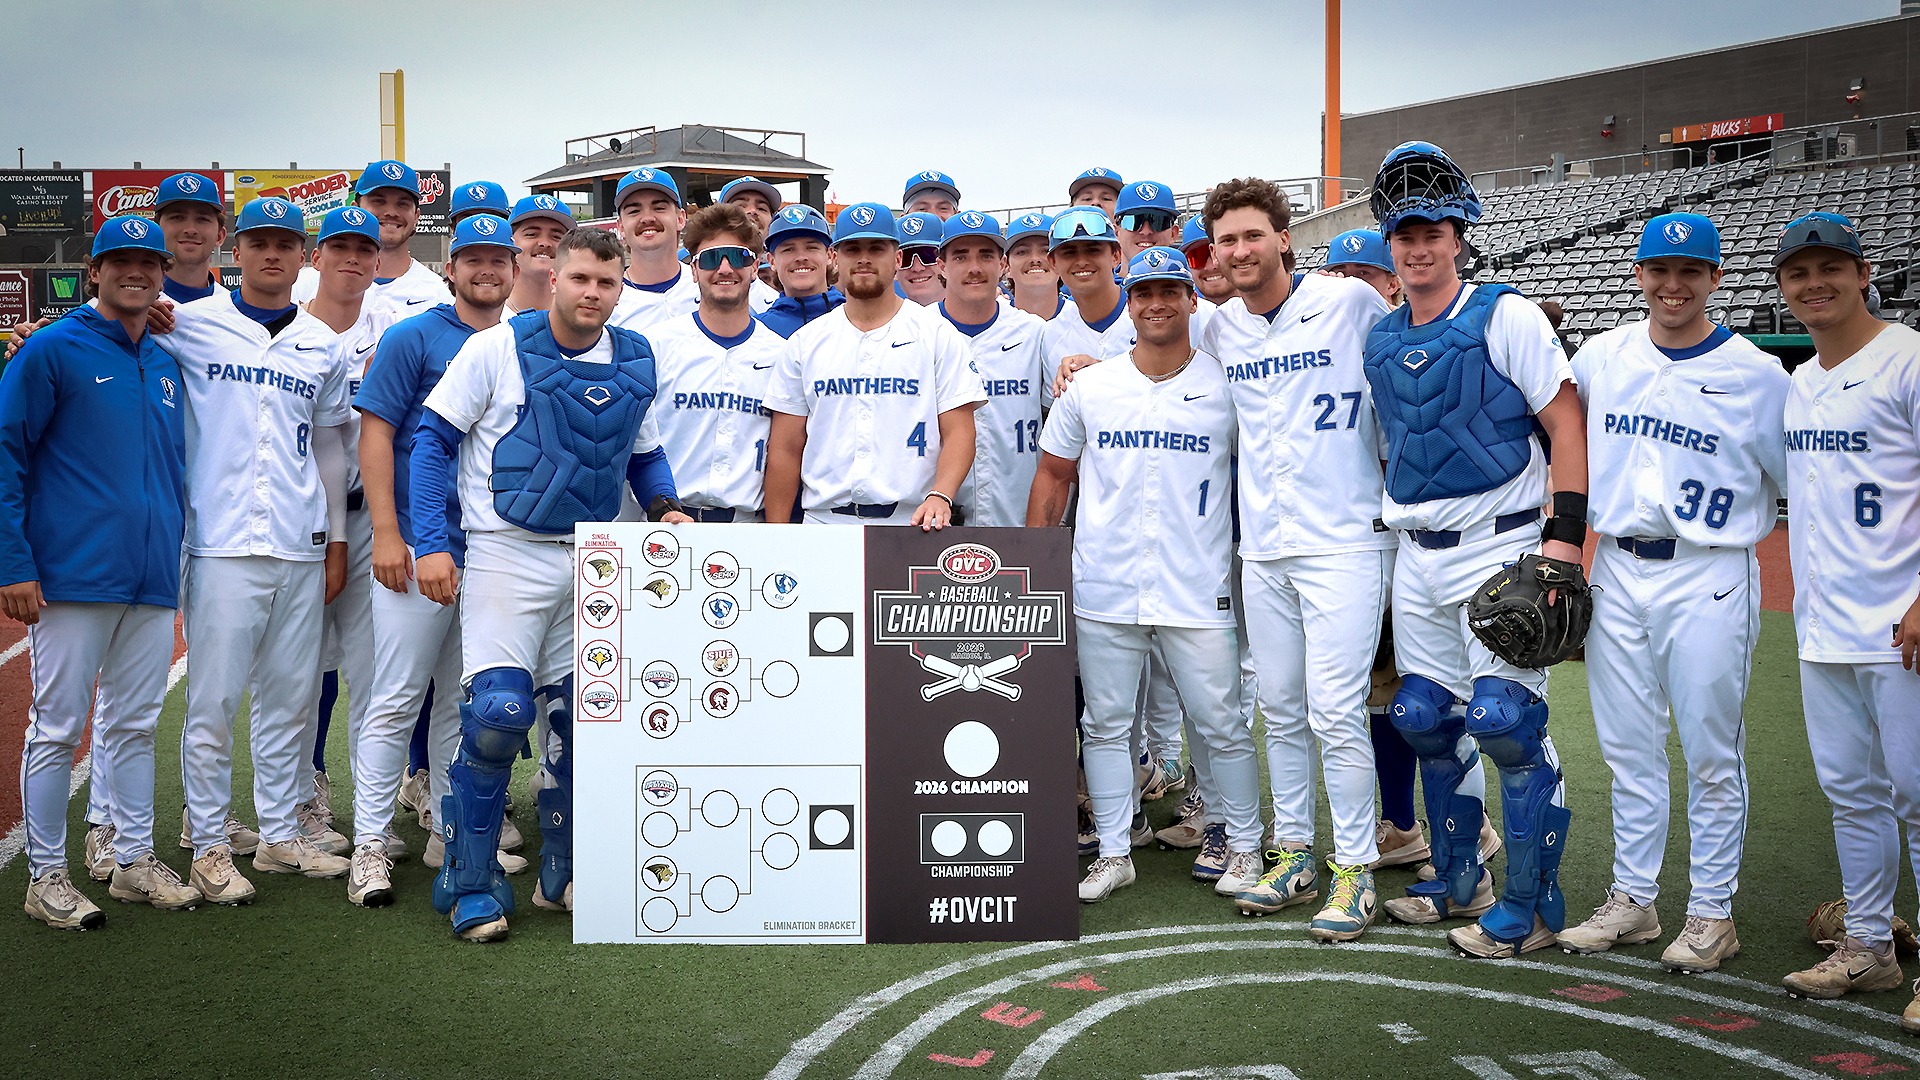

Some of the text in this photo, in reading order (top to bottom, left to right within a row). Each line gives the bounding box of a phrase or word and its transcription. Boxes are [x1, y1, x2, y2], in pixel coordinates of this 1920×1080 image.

[1710, 119, 1741, 138] BUCKS
[288, 173, 349, 203] PONDER
[304, 192, 334, 207] SERVICE
[310, 199, 343, 215] COOLING
[0, 281, 22, 292] ance
[0, 313, 21, 326] 37
[1226, 348, 1332, 384] PANTHERS
[207, 363, 317, 401] PANTHERS
[813, 377, 920, 397] PANTHERS
[983, 378, 1029, 397] HERS
[674, 391, 772, 417] PANTHER
[1313, 390, 1362, 433] 27
[296, 422, 310, 457] 8
[906, 421, 927, 457] 4
[1014, 419, 1038, 454] 13
[1098, 429, 1210, 454] PANTHERS
[1604, 413, 1720, 456] PANTHERS
[1198, 479, 1210, 517] 1
[1674, 478, 1735, 530] 38
[1852, 482, 1883, 529] 6
[591, 533, 610, 541] SINGLE
[652, 550, 676, 560] SEMO
[952, 557, 986, 572] OVC
[712, 570, 736, 581] SEMO
[939, 585, 999, 603] BASEBALL
[887, 604, 1053, 633] CHAMPIONSHIP
[707, 648, 734, 661] SIUE
[950, 652, 982, 661] MARION,
[956, 642, 986, 653] 2026
[913, 780, 1029, 795] 2026 CHAMPION
[930, 865, 1015, 878] CHAMPIONSHIP
[929, 896, 1018, 924] #OVCIT
[763, 920, 857, 931] ELIMINATION BRACKET
